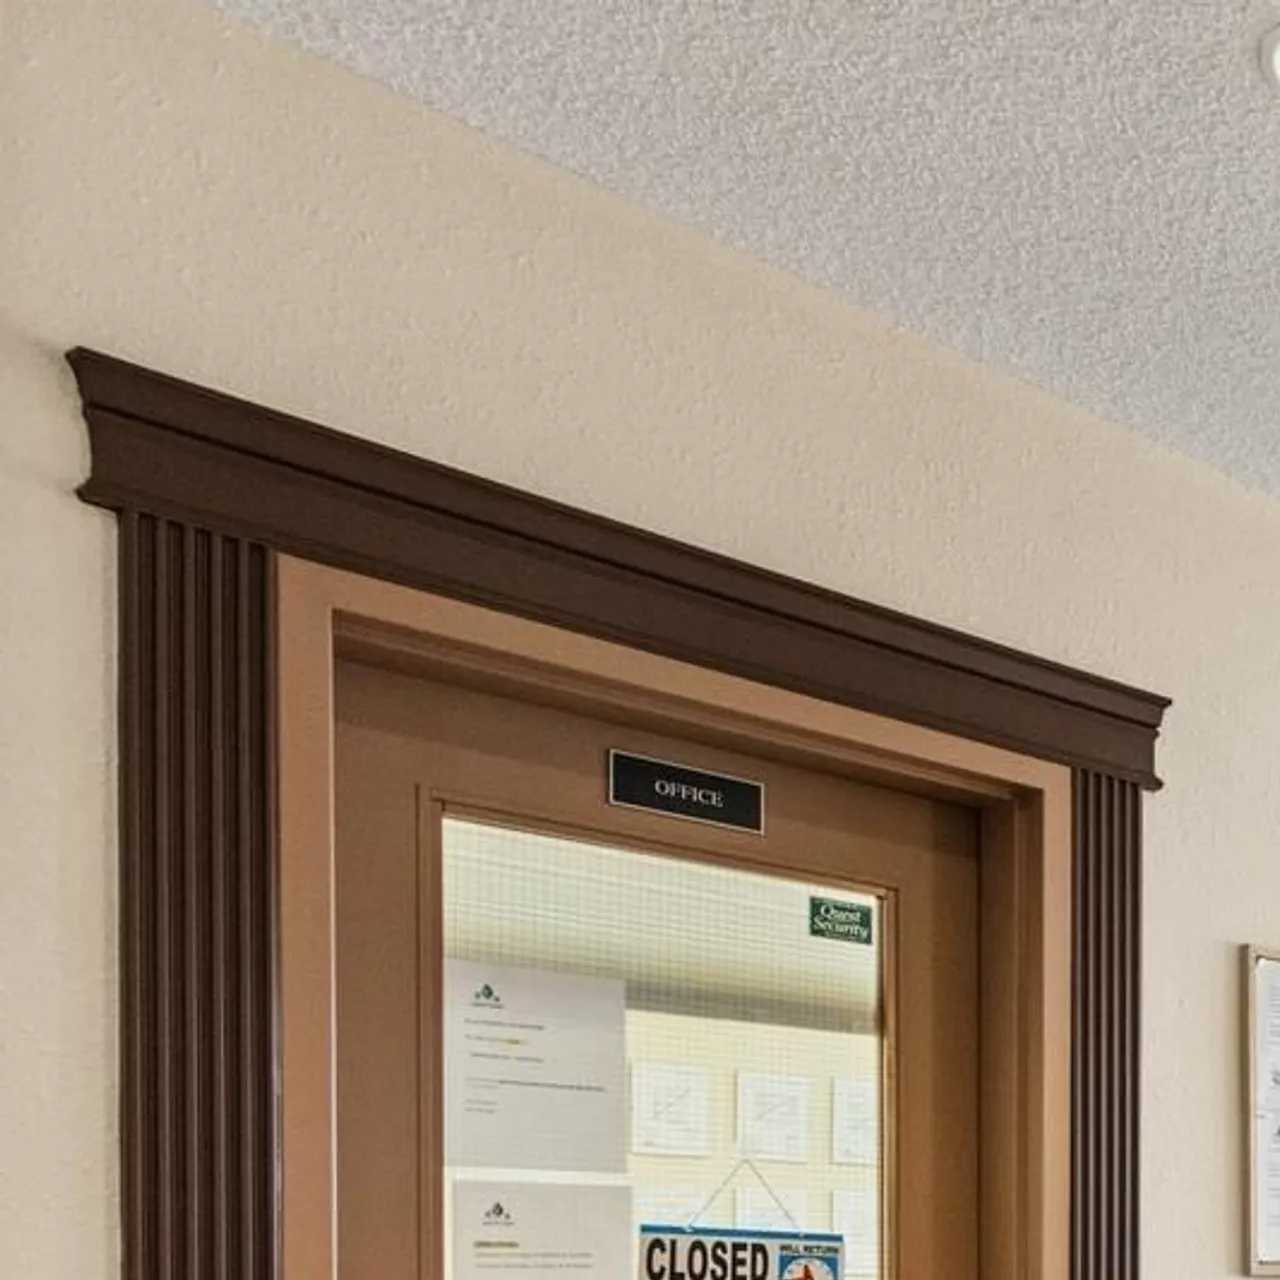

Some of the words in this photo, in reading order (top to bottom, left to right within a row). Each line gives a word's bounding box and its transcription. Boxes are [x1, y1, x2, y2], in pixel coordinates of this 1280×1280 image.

[654, 779, 724, 807] OFFICE
[813, 915, 870, 939] Security
[803, 1244, 839, 1254] RETURN
